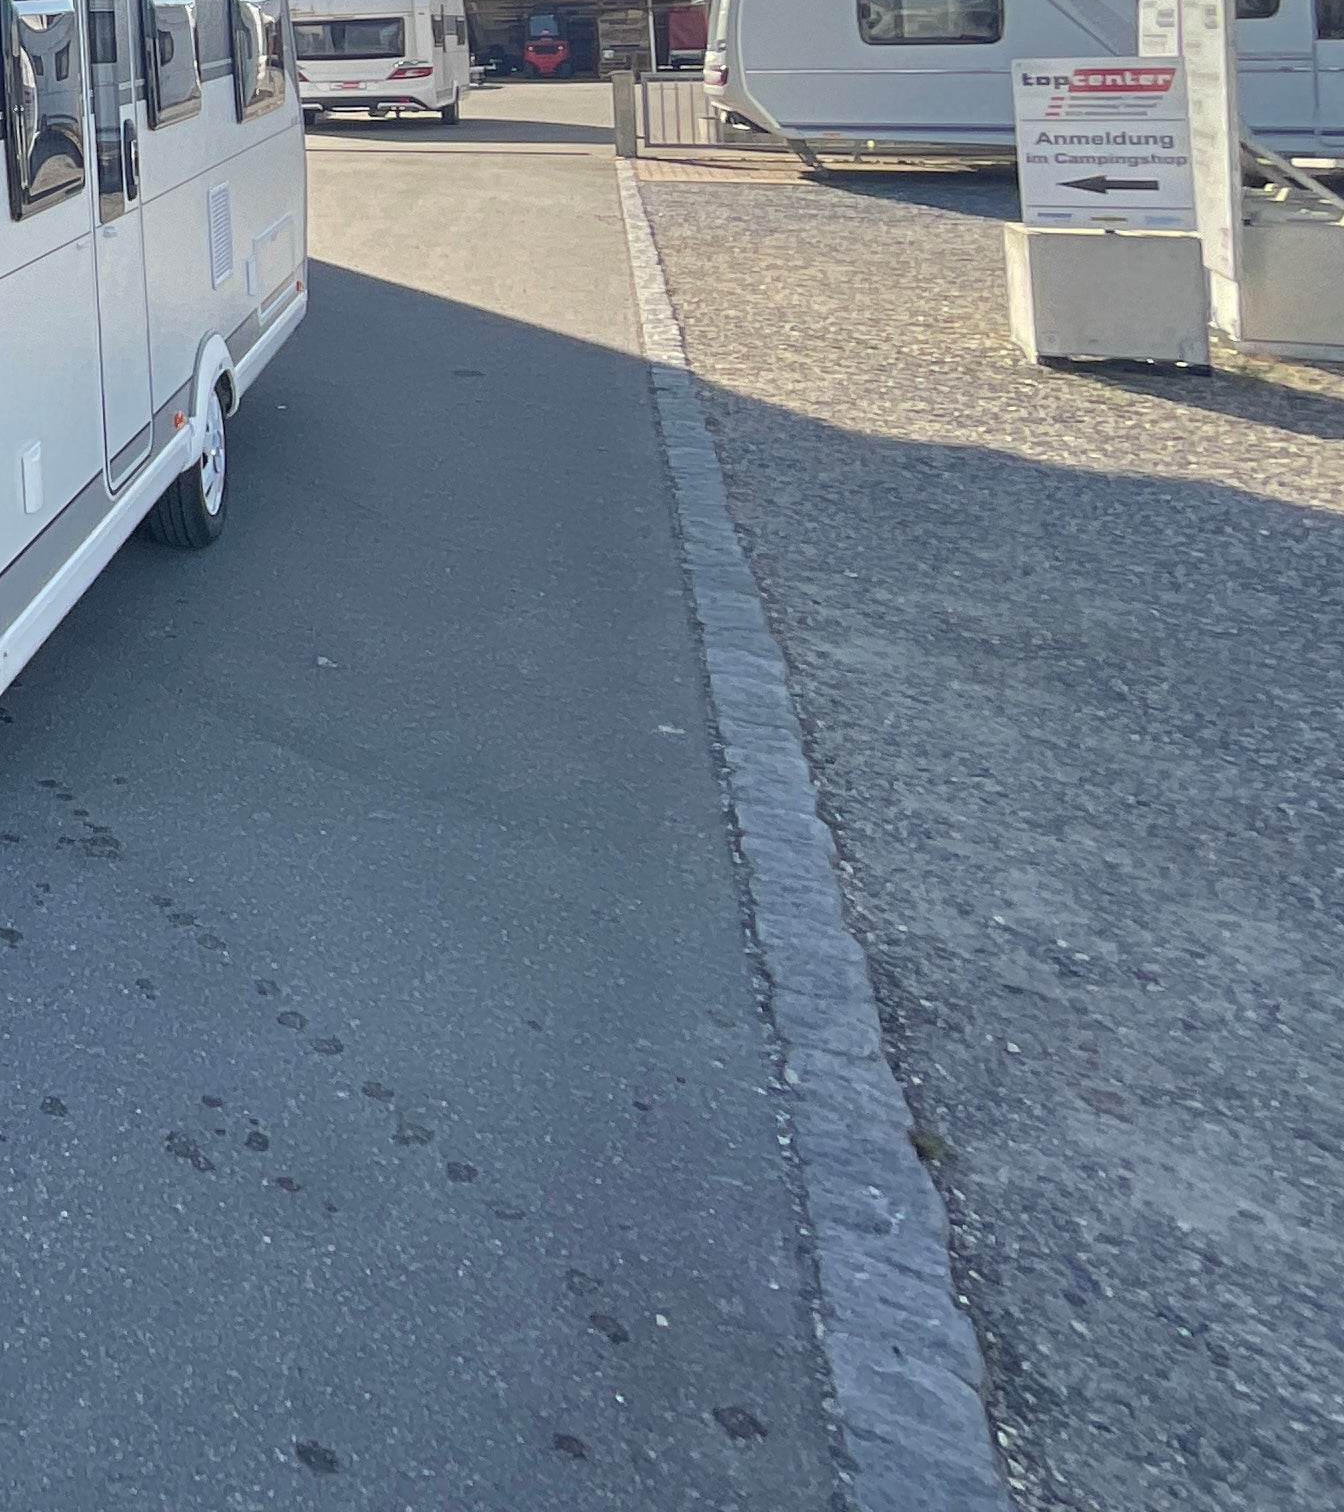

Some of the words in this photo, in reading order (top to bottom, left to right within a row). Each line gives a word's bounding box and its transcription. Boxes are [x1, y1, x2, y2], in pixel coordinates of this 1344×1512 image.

[1035, 131, 1175, 149] Anmeldung
[1026, 152, 1048, 164] im
[1054, 152, 1188, 167] Campingshop
